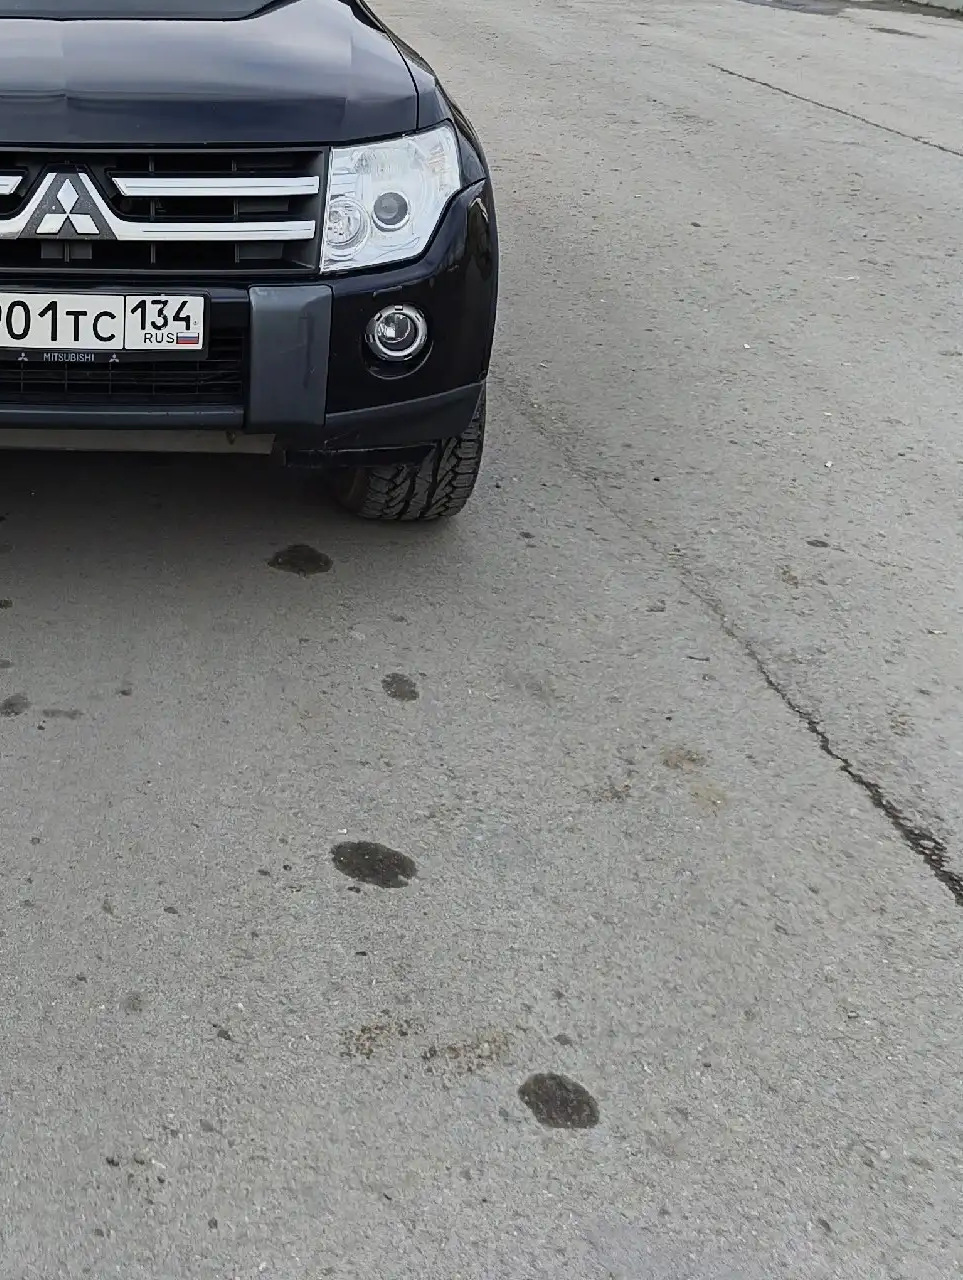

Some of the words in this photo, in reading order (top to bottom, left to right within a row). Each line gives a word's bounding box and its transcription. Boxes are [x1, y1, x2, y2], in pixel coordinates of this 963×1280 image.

[130, 298, 192, 332] 134
[143, 332, 175, 345] RUS
[43, 352, 95, 362] MITSUBISHI
